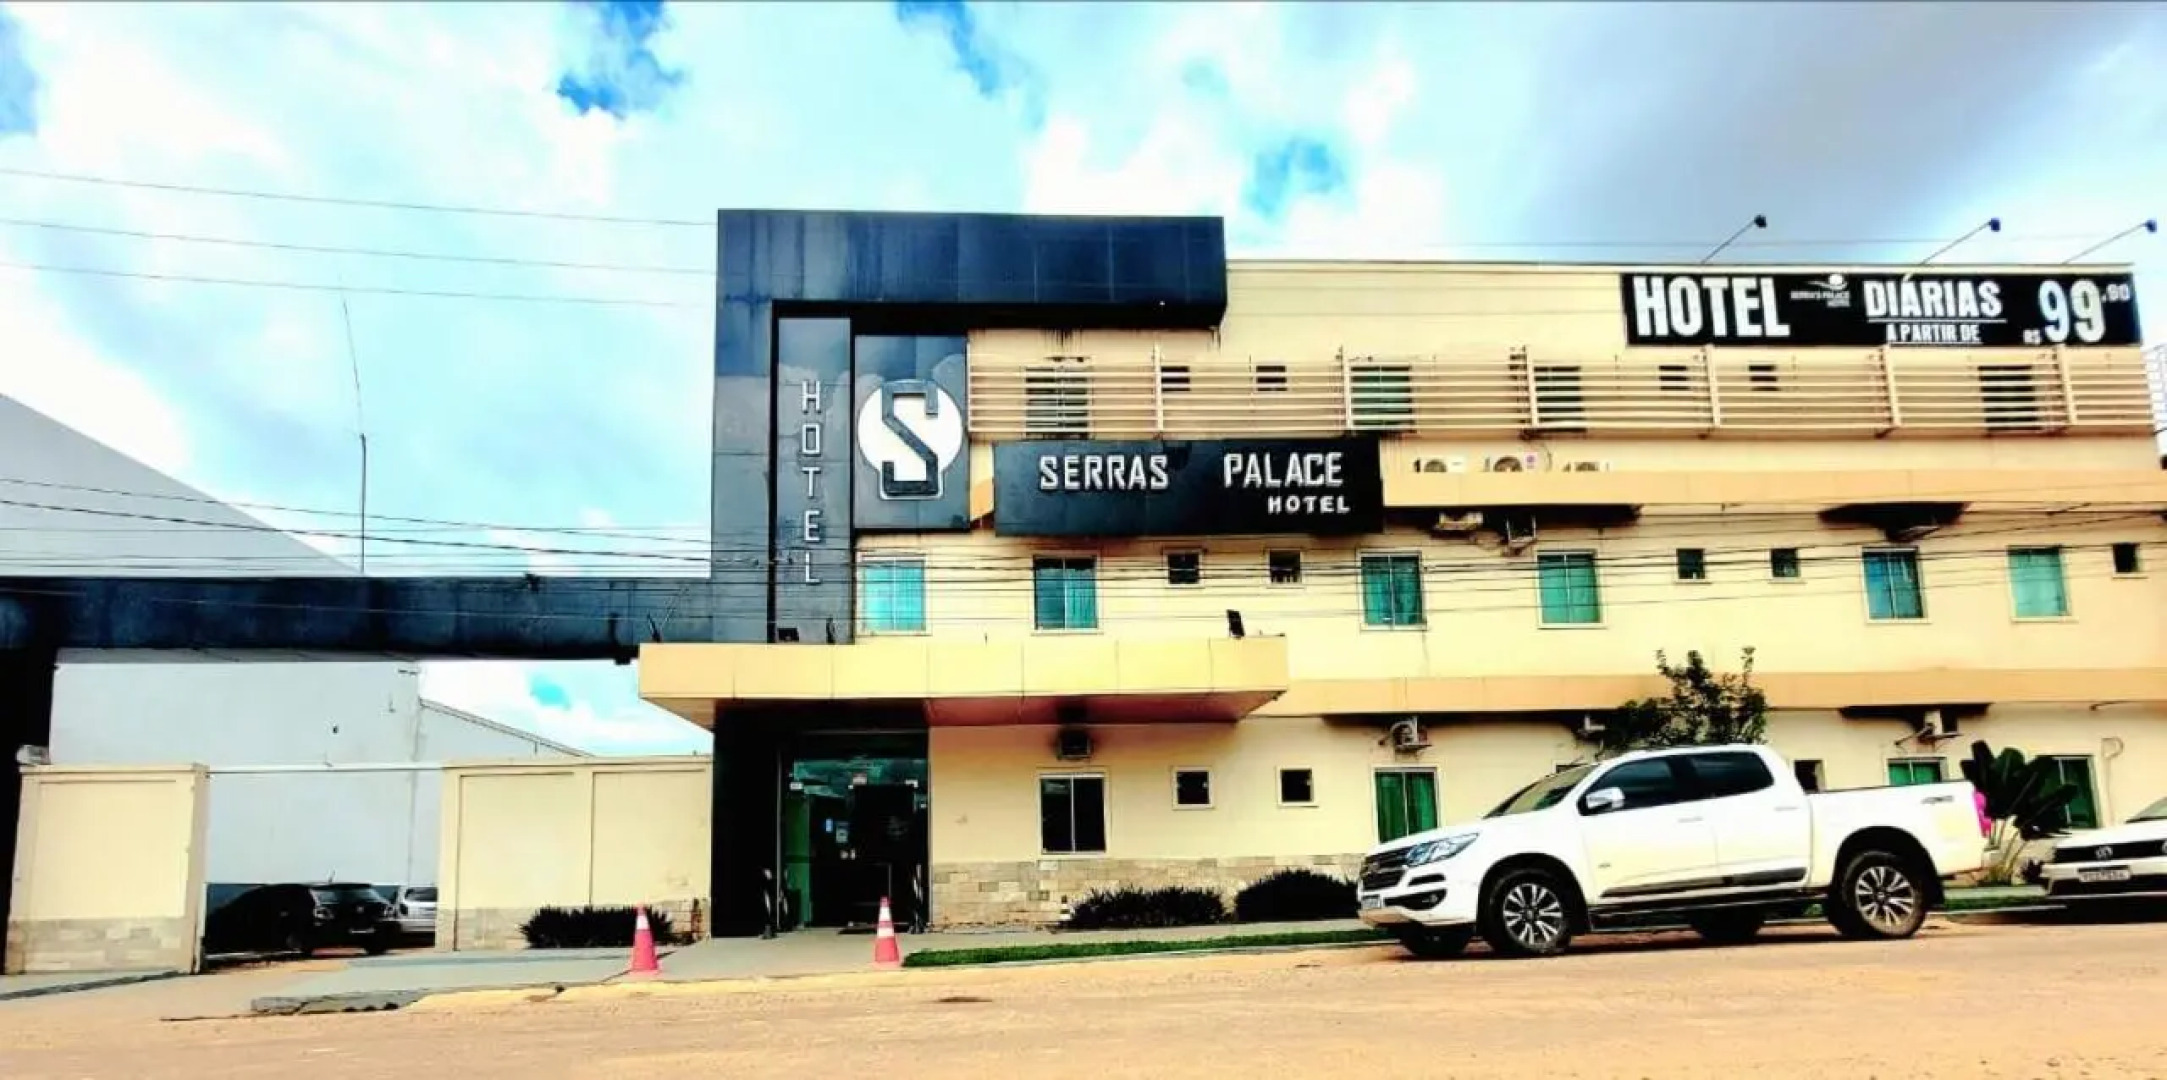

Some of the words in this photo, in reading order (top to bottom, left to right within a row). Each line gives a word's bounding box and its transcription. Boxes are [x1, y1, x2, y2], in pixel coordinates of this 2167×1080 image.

[1632, 275, 1791, 337] HOTEL
[1863, 273, 2003, 318] DIÁRIAS
[1886, 323, 1897, 342] A
[1900, 323, 1958, 342] PARTIR
[1960, 323, 1982, 342] DE
[802, 380, 821, 584] HOTEL
[1039, 454, 1169, 490] SERRAS
[1223, 451, 1344, 488] PALACE
[1267, 495, 1351, 514] HOTEL
